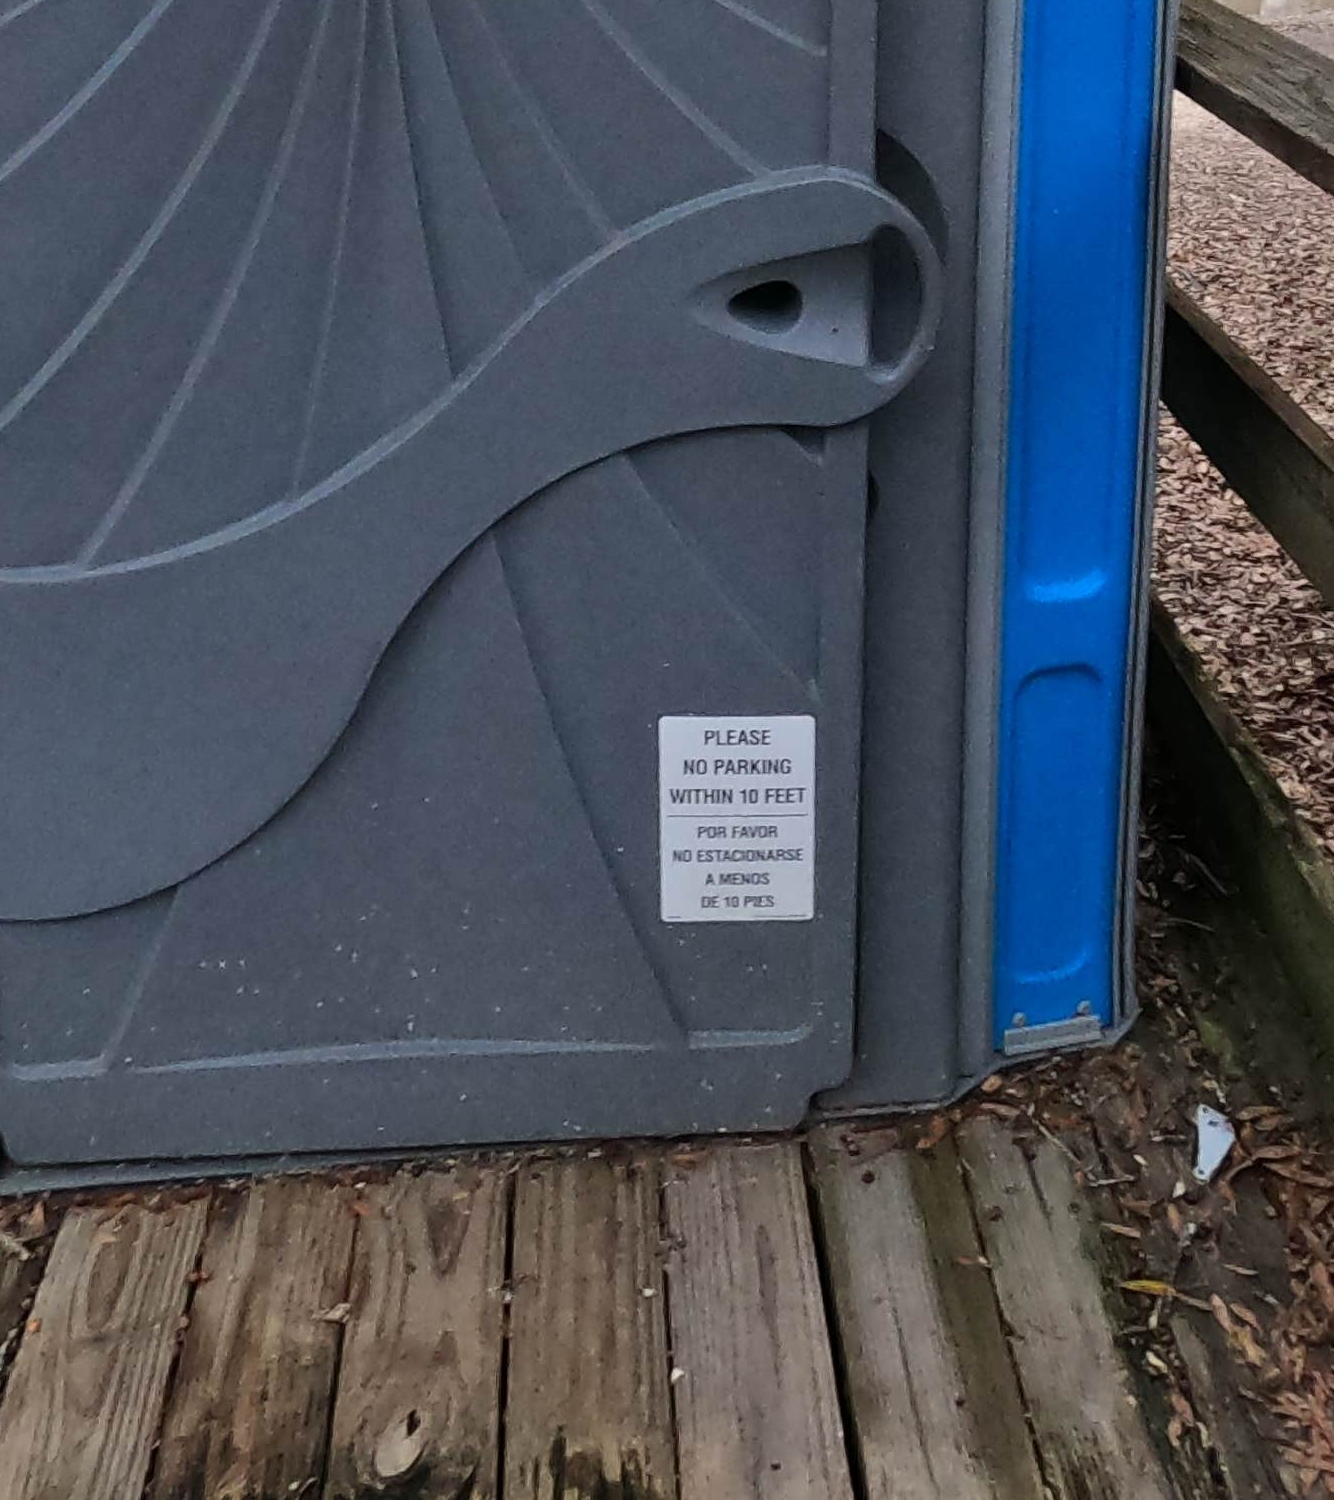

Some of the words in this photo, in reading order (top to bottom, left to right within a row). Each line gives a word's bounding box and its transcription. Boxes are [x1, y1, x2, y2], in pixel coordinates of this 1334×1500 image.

[704, 729, 772, 746] PLEASE
[683, 759, 708, 775] NO
[714, 758, 792, 775] PARKING
[670, 788, 733, 805] WITHIN
[740, 788, 759, 804] 10
[765, 788, 807, 804] FEET
[697, 826, 727, 839] POR
[731, 826, 778, 838] FAVOR
[672, 850, 692, 863] NO
[697, 849, 804, 863] ESTACIONARSE
[705, 873, 715, 885] A
[719, 872, 770, 885] MENOS
[701, 896, 719, 909] DE
[724, 896, 739, 908] 10
[743, 895, 775, 908] PIES
